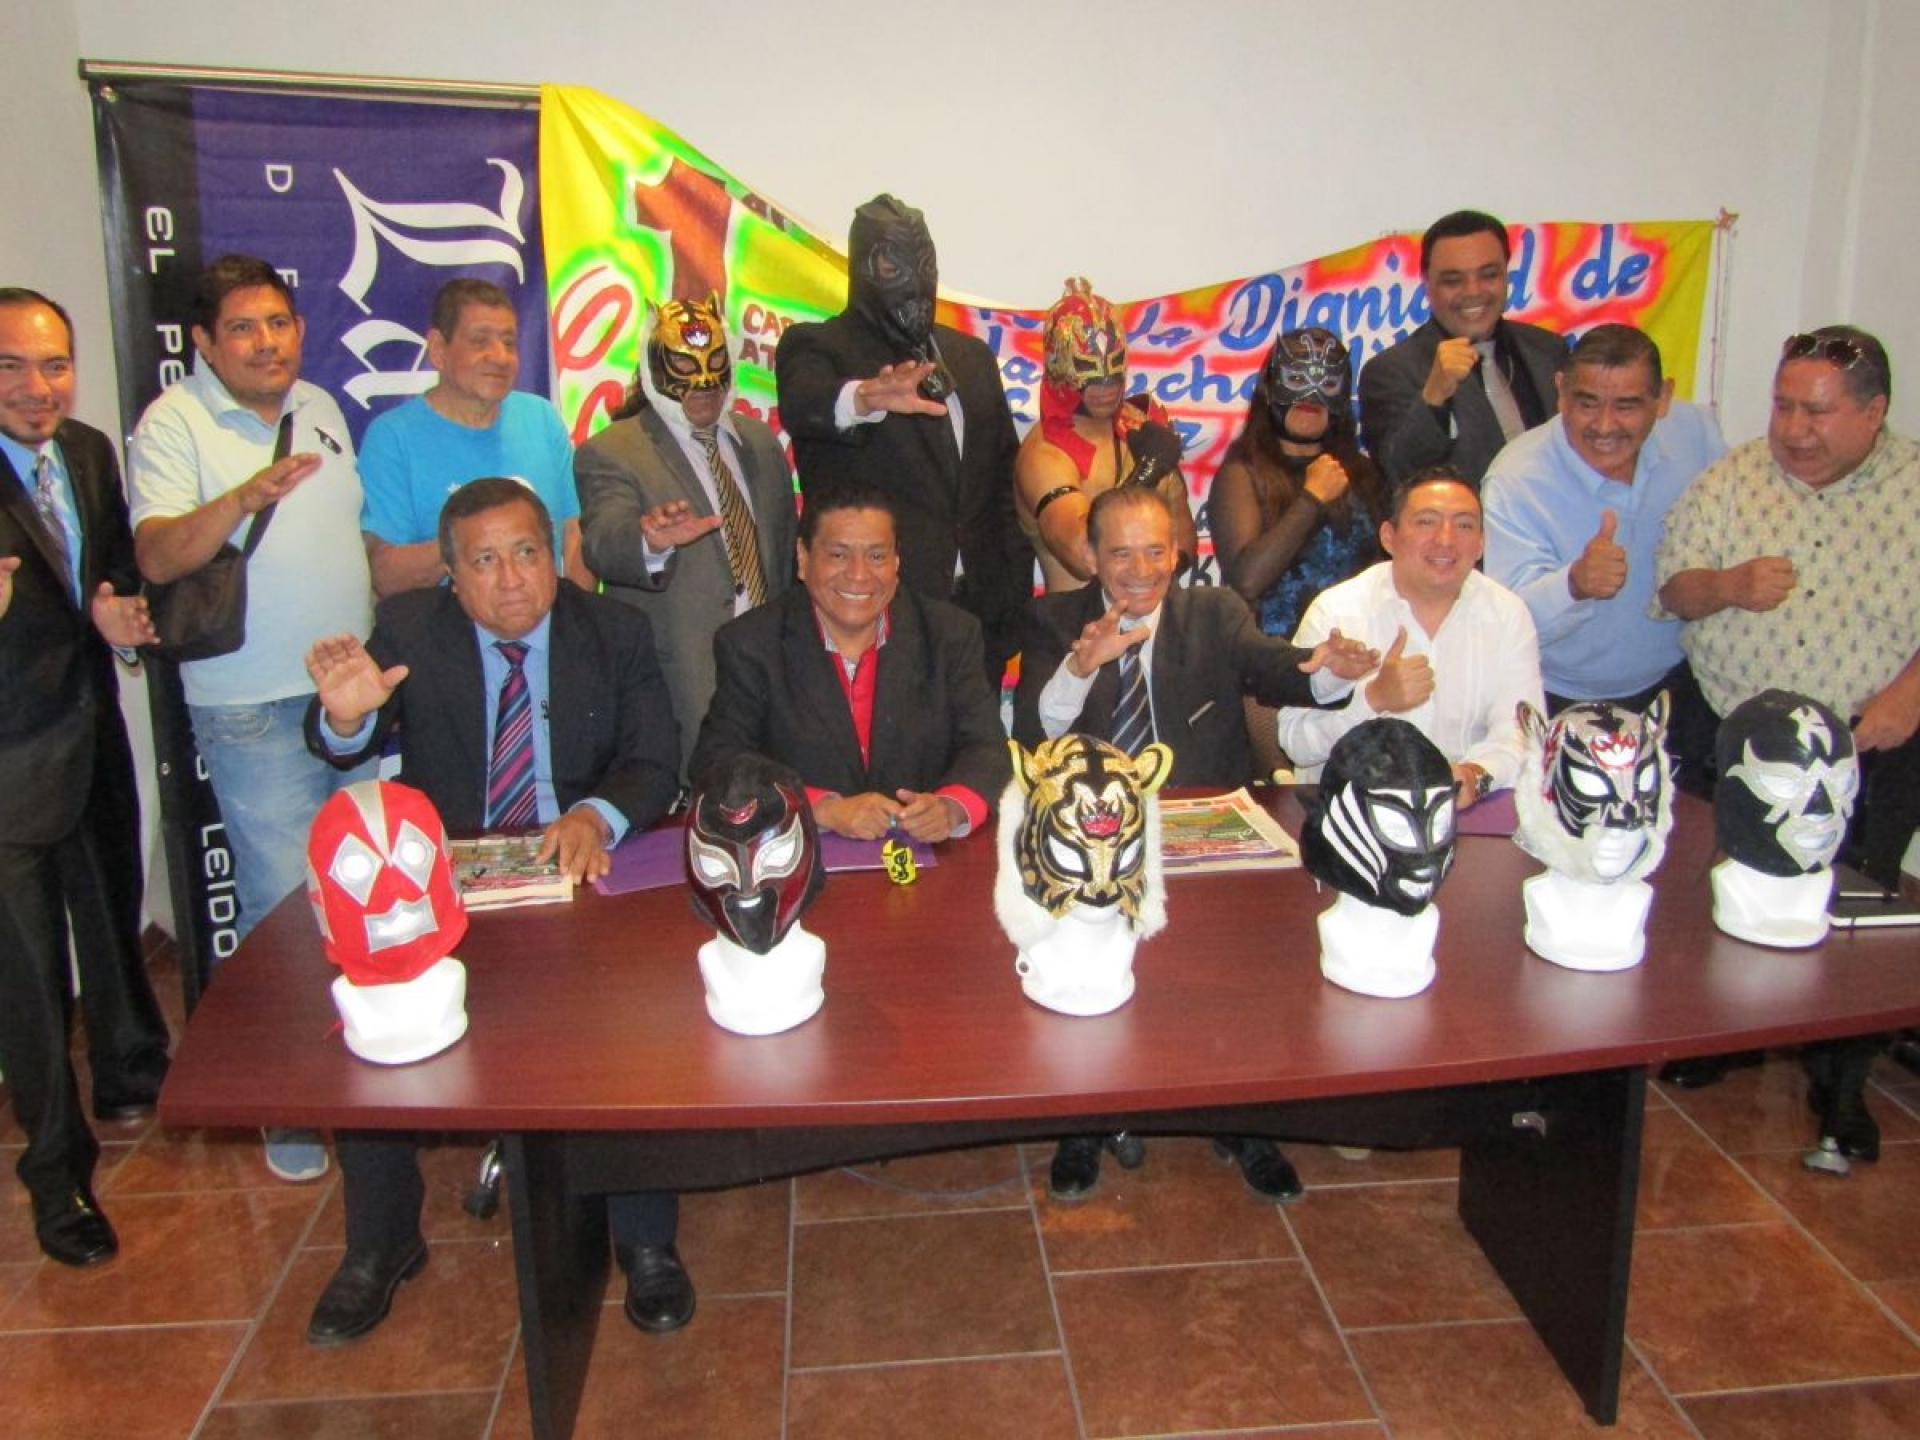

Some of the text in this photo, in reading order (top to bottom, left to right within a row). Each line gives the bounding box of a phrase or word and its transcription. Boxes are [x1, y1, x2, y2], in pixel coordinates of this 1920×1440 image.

[145, 206, 176, 275] EL
[1219, 228, 1534, 351] Dignid
[1571, 223, 1651, 301] de
